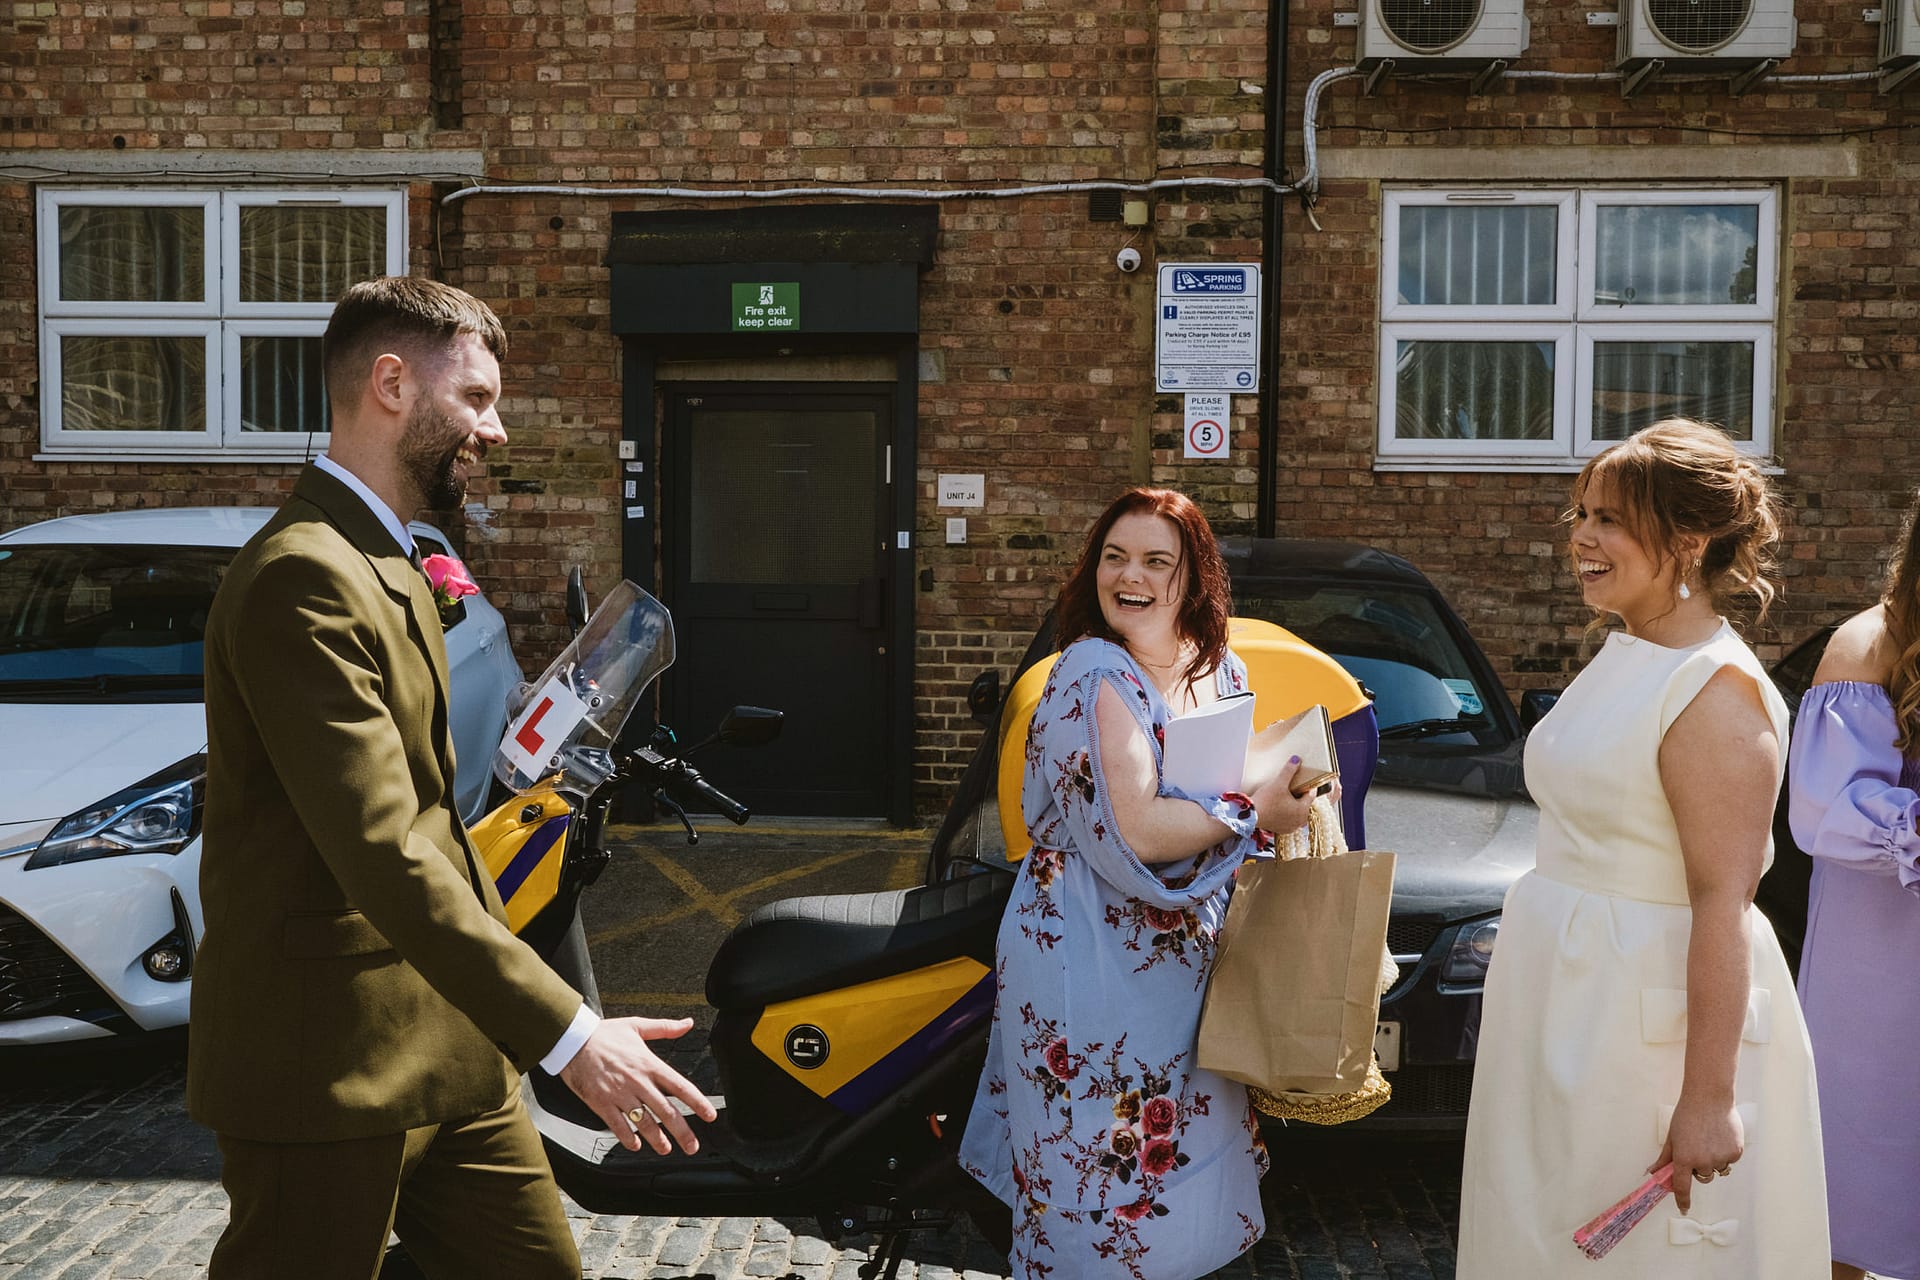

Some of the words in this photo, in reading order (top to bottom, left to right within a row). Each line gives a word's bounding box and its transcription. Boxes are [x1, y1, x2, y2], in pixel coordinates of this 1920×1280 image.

[1203, 275, 1242, 283] SPRING
[745, 306, 764, 316] Fire
[768, 306, 786, 315] exit
[738, 316, 764, 328] keep
[768, 316, 793, 326] clear
[1202, 427, 1212, 441] 5
[514, 696, 554, 756] L
